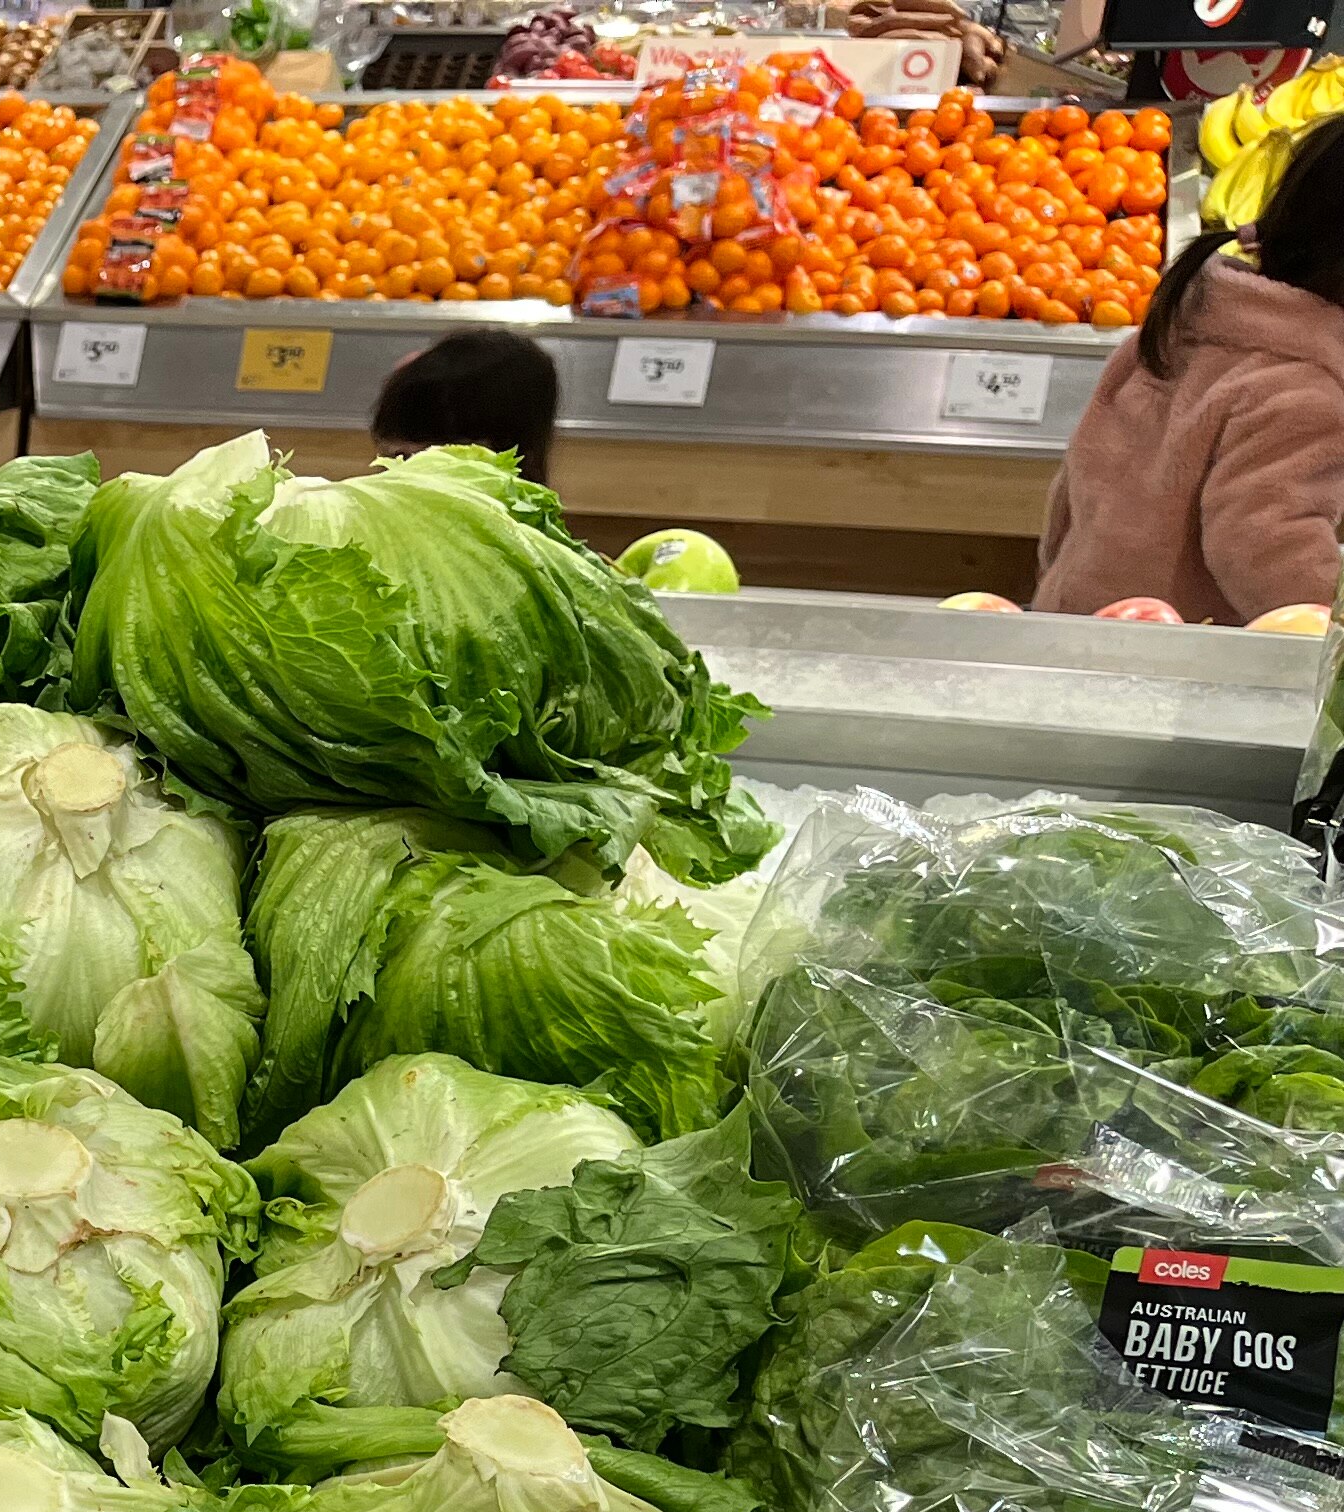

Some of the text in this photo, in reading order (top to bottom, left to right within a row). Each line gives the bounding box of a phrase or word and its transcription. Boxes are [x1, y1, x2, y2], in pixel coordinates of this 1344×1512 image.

[1154, 1260, 1211, 1281] coles
[1130, 1301, 1246, 1325] AUSTRALIAN
[1123, 1319, 1297, 1371] BABY COS
[1117, 1361, 1229, 1396] LETTUCE
